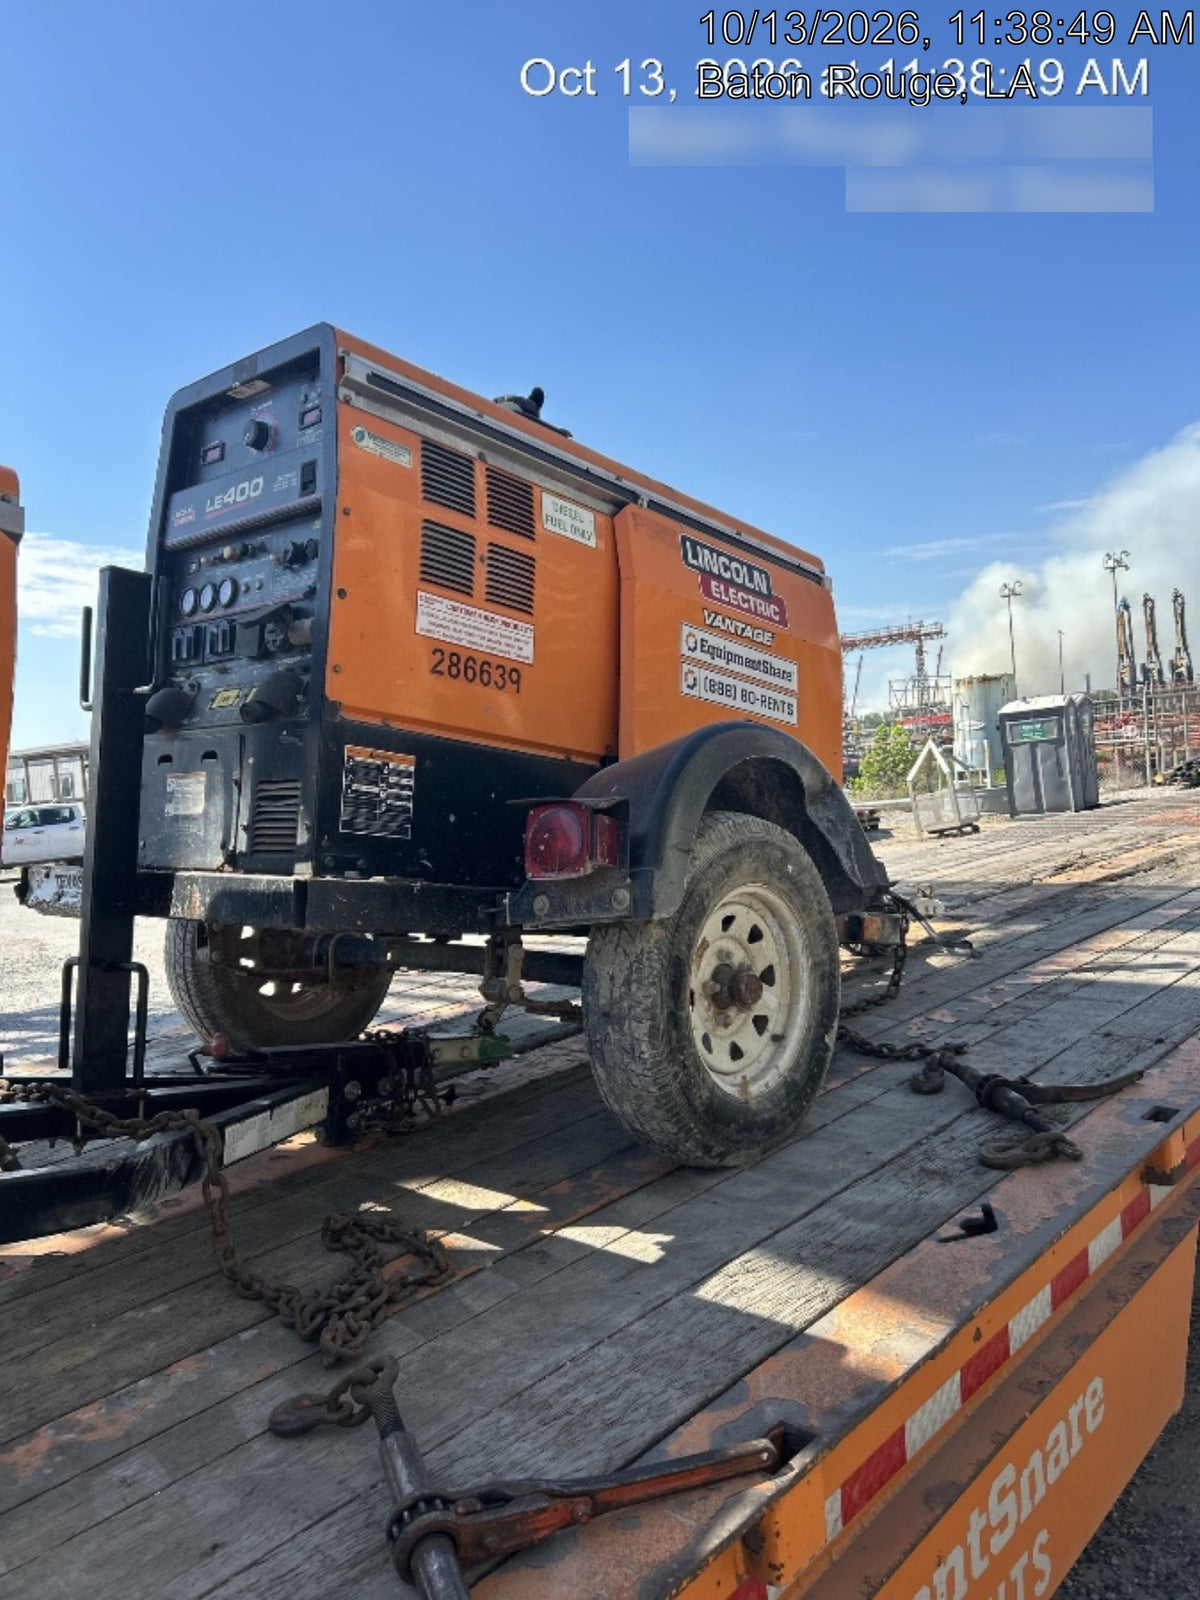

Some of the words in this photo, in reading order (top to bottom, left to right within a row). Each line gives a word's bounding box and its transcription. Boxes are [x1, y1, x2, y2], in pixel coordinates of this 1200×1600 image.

[205, 476, 264, 513] LE400
[545, 513, 568, 532] FUEL
[685, 539, 769, 595] LINCOLN
[710, 579, 780, 621] ELECTRIC
[703, 608, 776, 648] VANTAGE
[430, 647, 522, 694] 286639
[699, 637, 793, 682] EquipmentShare
